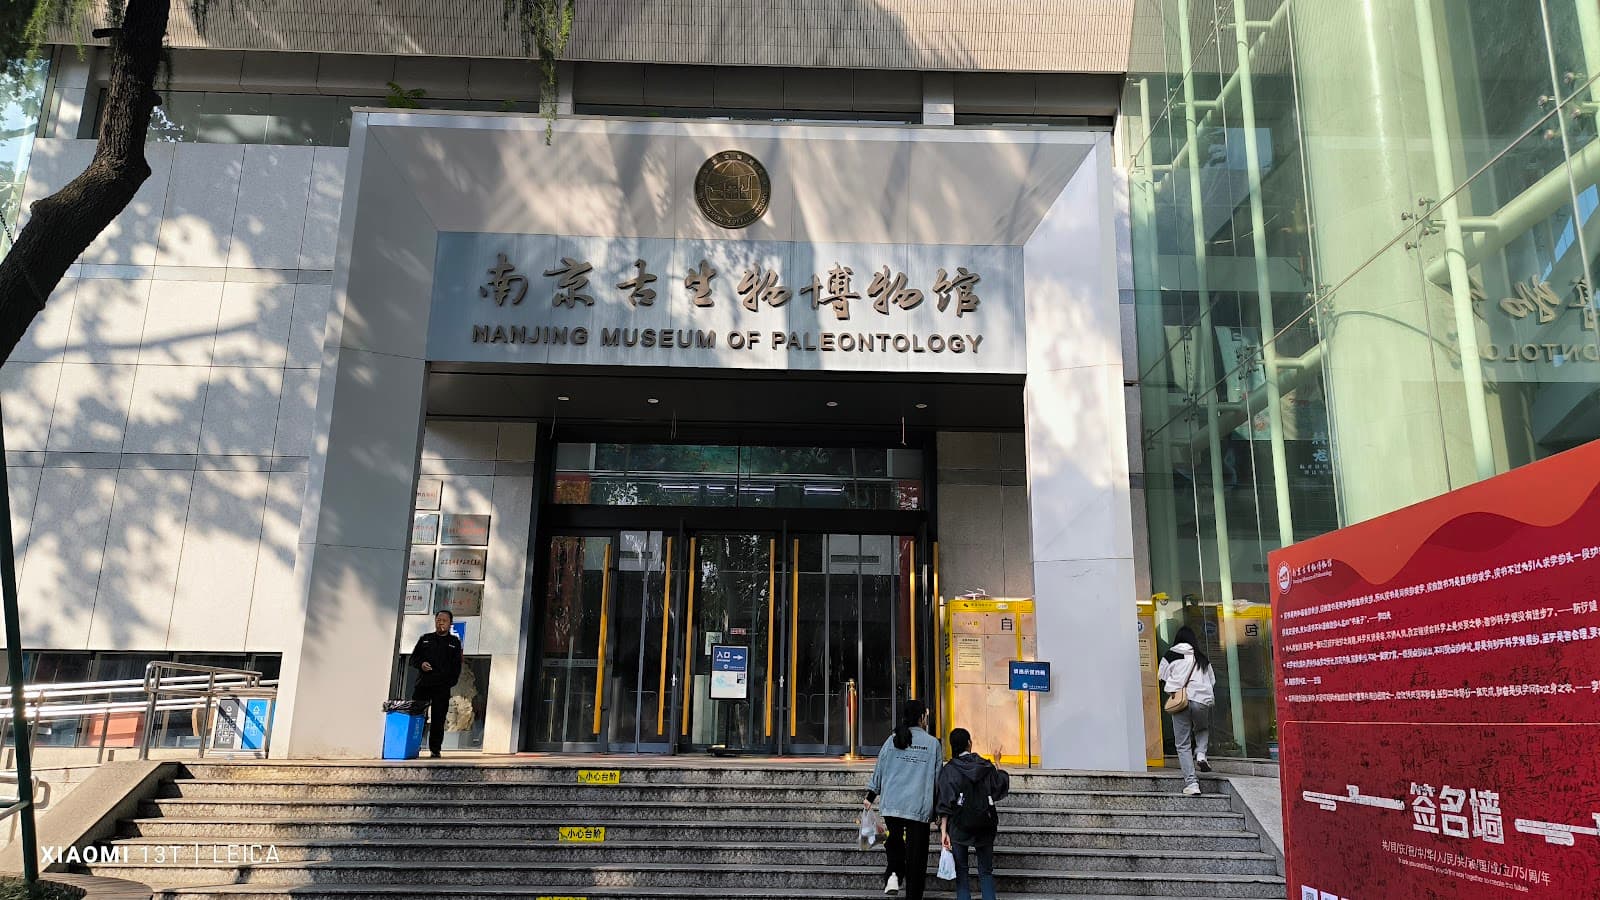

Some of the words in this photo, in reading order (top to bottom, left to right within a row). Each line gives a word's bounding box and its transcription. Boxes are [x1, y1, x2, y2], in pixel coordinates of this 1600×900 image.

[479, 253, 981, 320] 南京古生物博物馆
[471, 324, 589, 345] NANJING
[600, 327, 717, 348] MUSEUM
[726, 330, 761, 350] OF
[771, 331, 984, 353] PALEONTOLOGY
[716, 651, 731, 659] 入口
[585, 772, 617, 780] 小心台阶
[1410, 782, 1504, 844] 签名墙
[567, 828, 602, 839] 小心台阶
